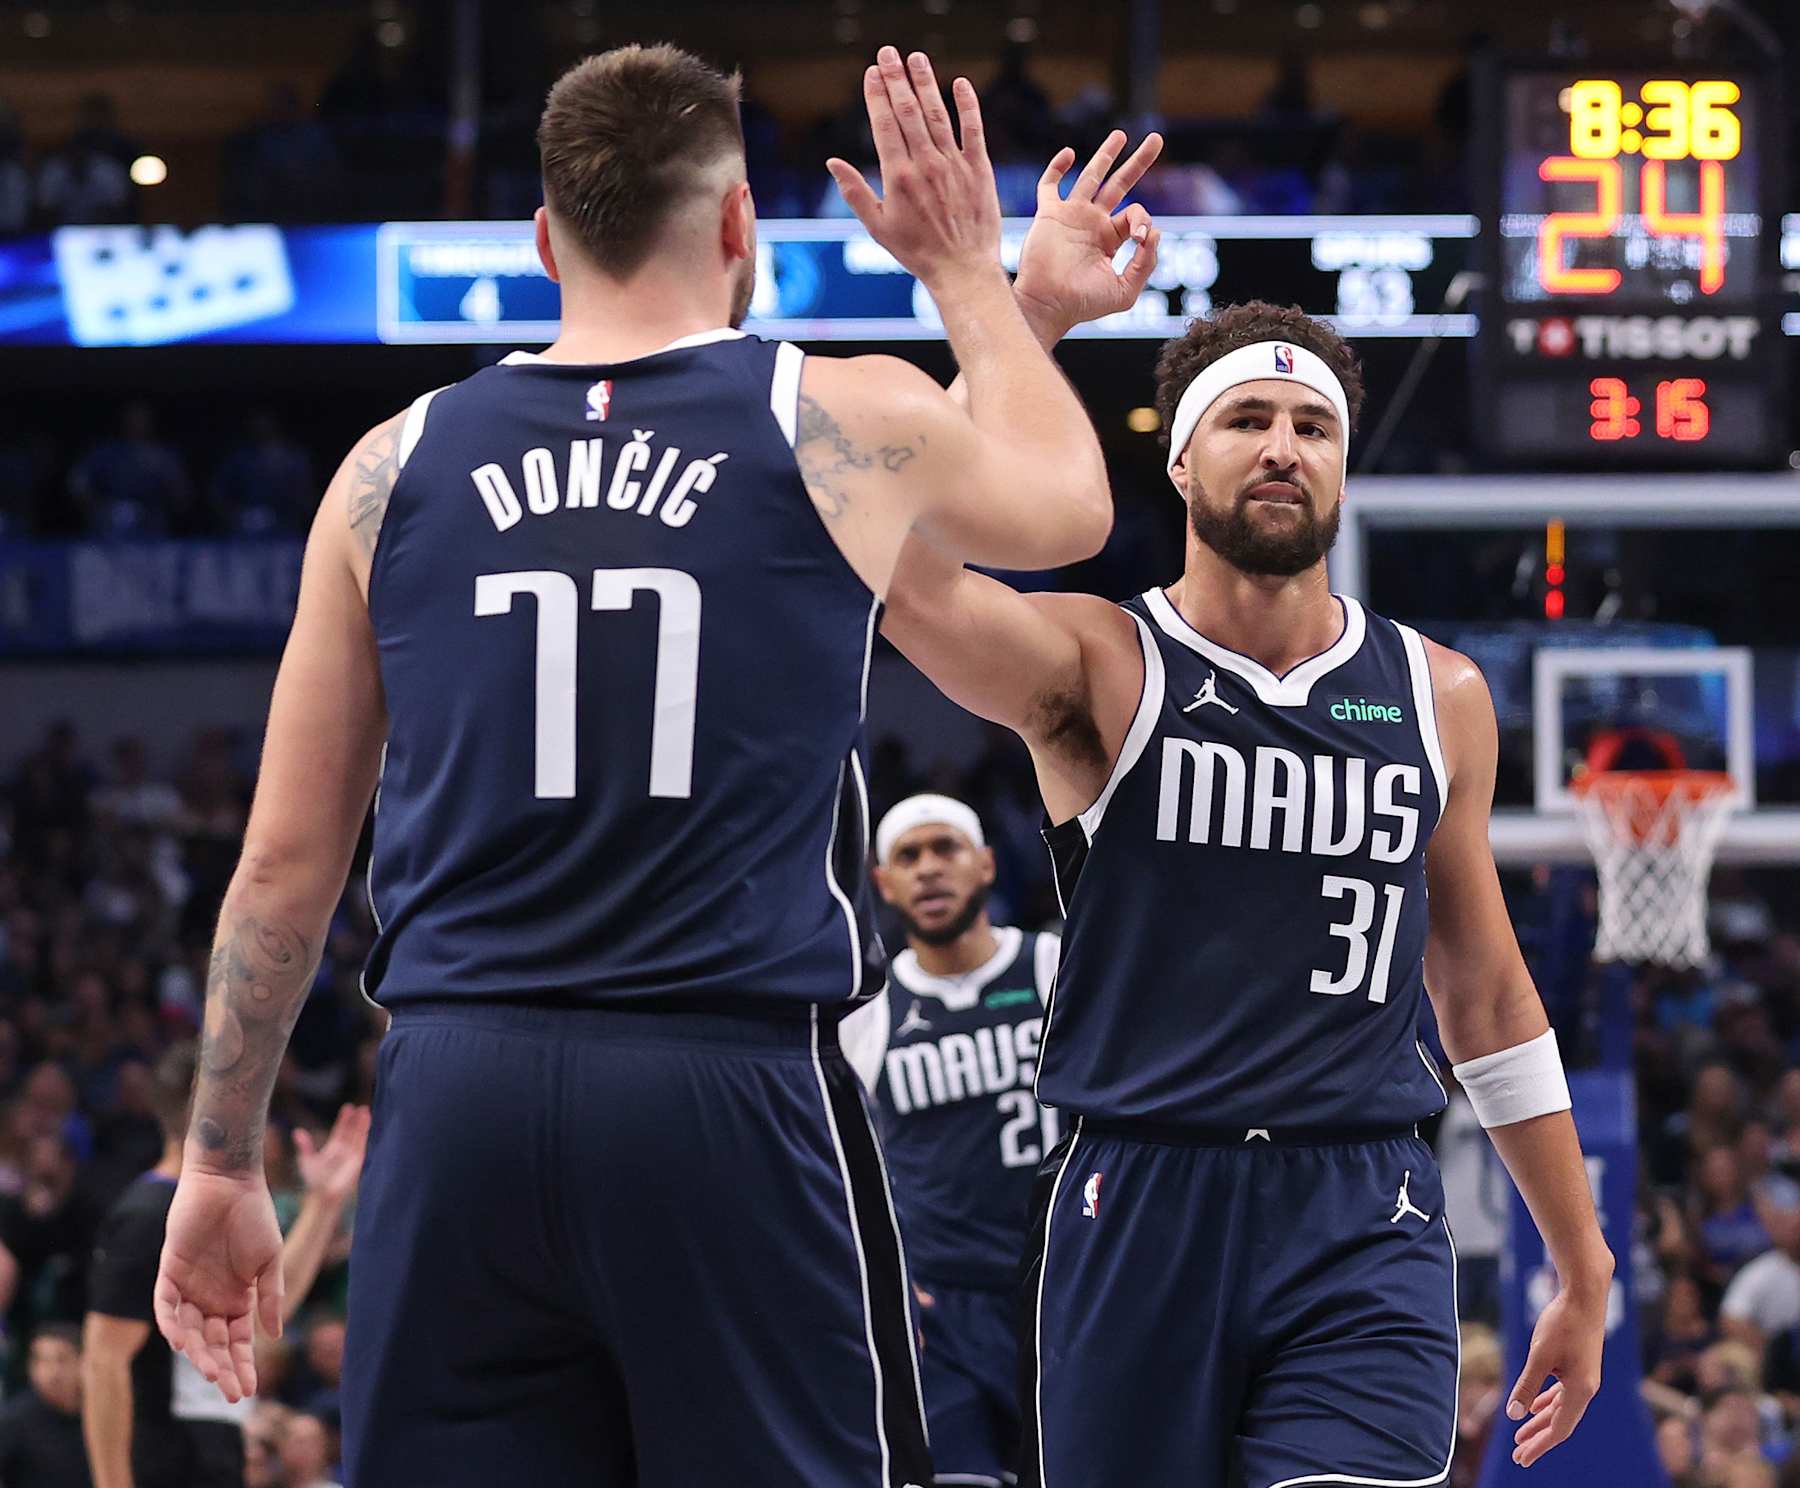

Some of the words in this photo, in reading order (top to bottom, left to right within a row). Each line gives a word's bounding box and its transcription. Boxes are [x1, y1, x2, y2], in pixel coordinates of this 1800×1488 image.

[1570, 80, 1741, 160] 8:36
[1538, 156, 1725, 294] 24
[1574, 315, 1760, 359] TISSOT
[470, 428, 729, 532] DONČIĆ
[474, 567, 702, 799] 77
[1330, 698, 1402, 723] chime
[1156, 737, 1421, 863] MAVS
[1310, 875, 1405, 1004] 31
[886, 1017, 1043, 1115] MAVS
